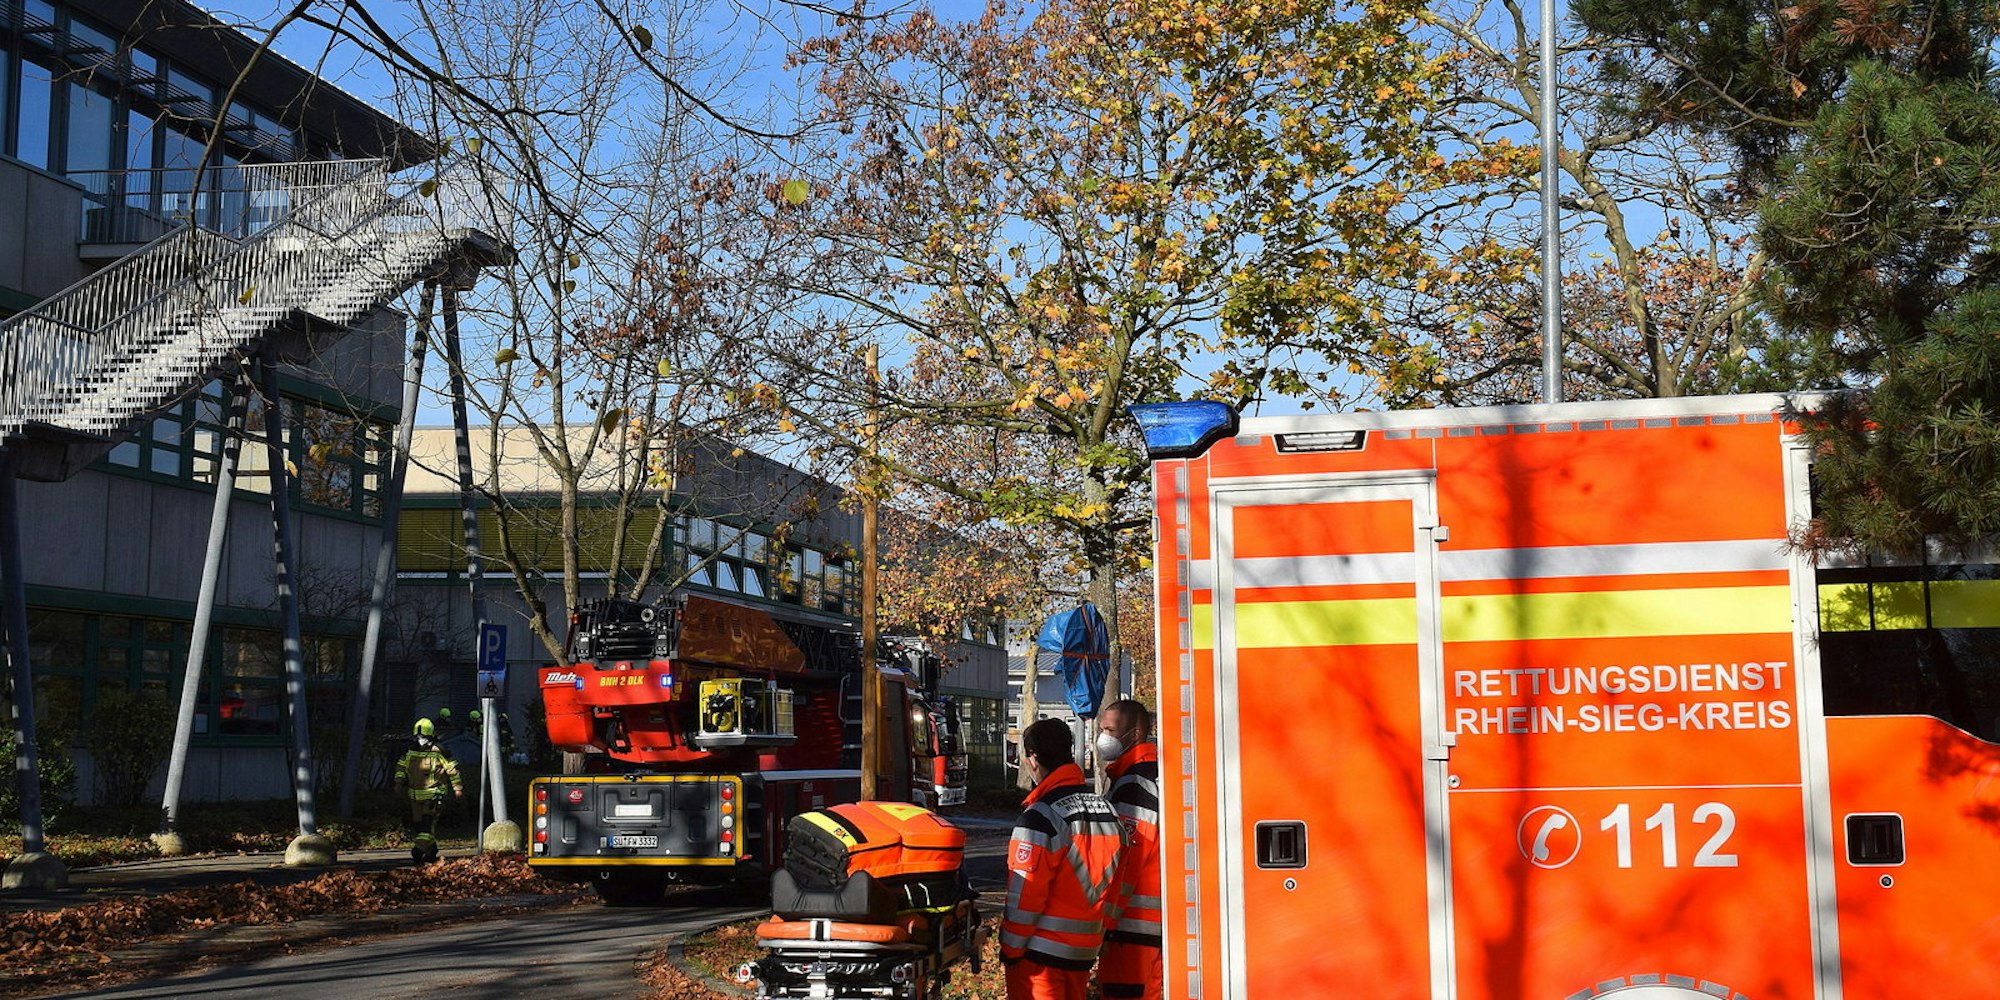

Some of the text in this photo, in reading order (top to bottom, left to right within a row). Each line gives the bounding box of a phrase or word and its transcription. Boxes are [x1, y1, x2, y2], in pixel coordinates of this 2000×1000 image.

[485, 630, 500, 665] P
[544, 672, 577, 685] Metz
[620, 675, 626, 686] 2
[1454, 662, 1787, 697] RETTUNGSDIENST
[1455, 700, 1792, 735] RHEIN-SIEG-KREIS
[1600, 801, 1740, 869] 112
